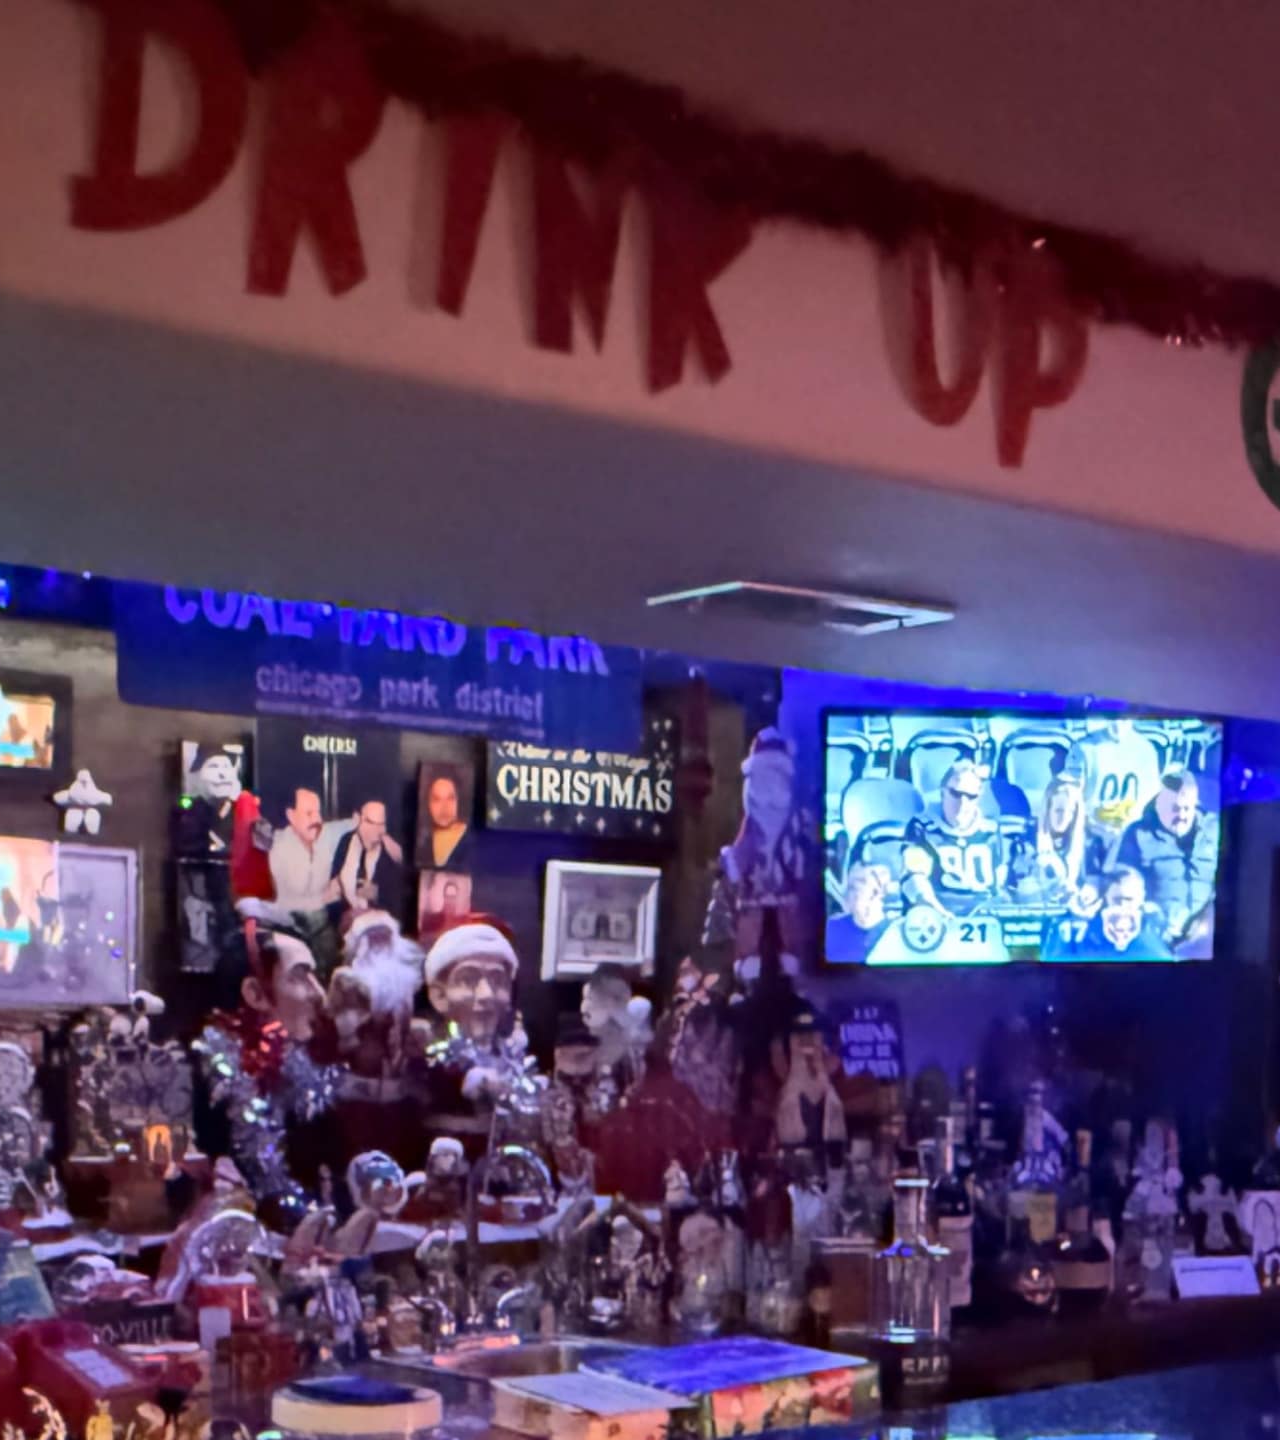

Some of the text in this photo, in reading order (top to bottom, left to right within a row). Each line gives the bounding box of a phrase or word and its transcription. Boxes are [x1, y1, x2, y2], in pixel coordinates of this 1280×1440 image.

[67, 0, 757, 397] DRINK
[883, 232, 1090, 470] UP
[256, 660, 544, 724] chicago park district
[496, 763, 673, 814] CHRISTMAS
[959, 922, 988, 944] 21
[1058, 920, 1089, 944] 17
